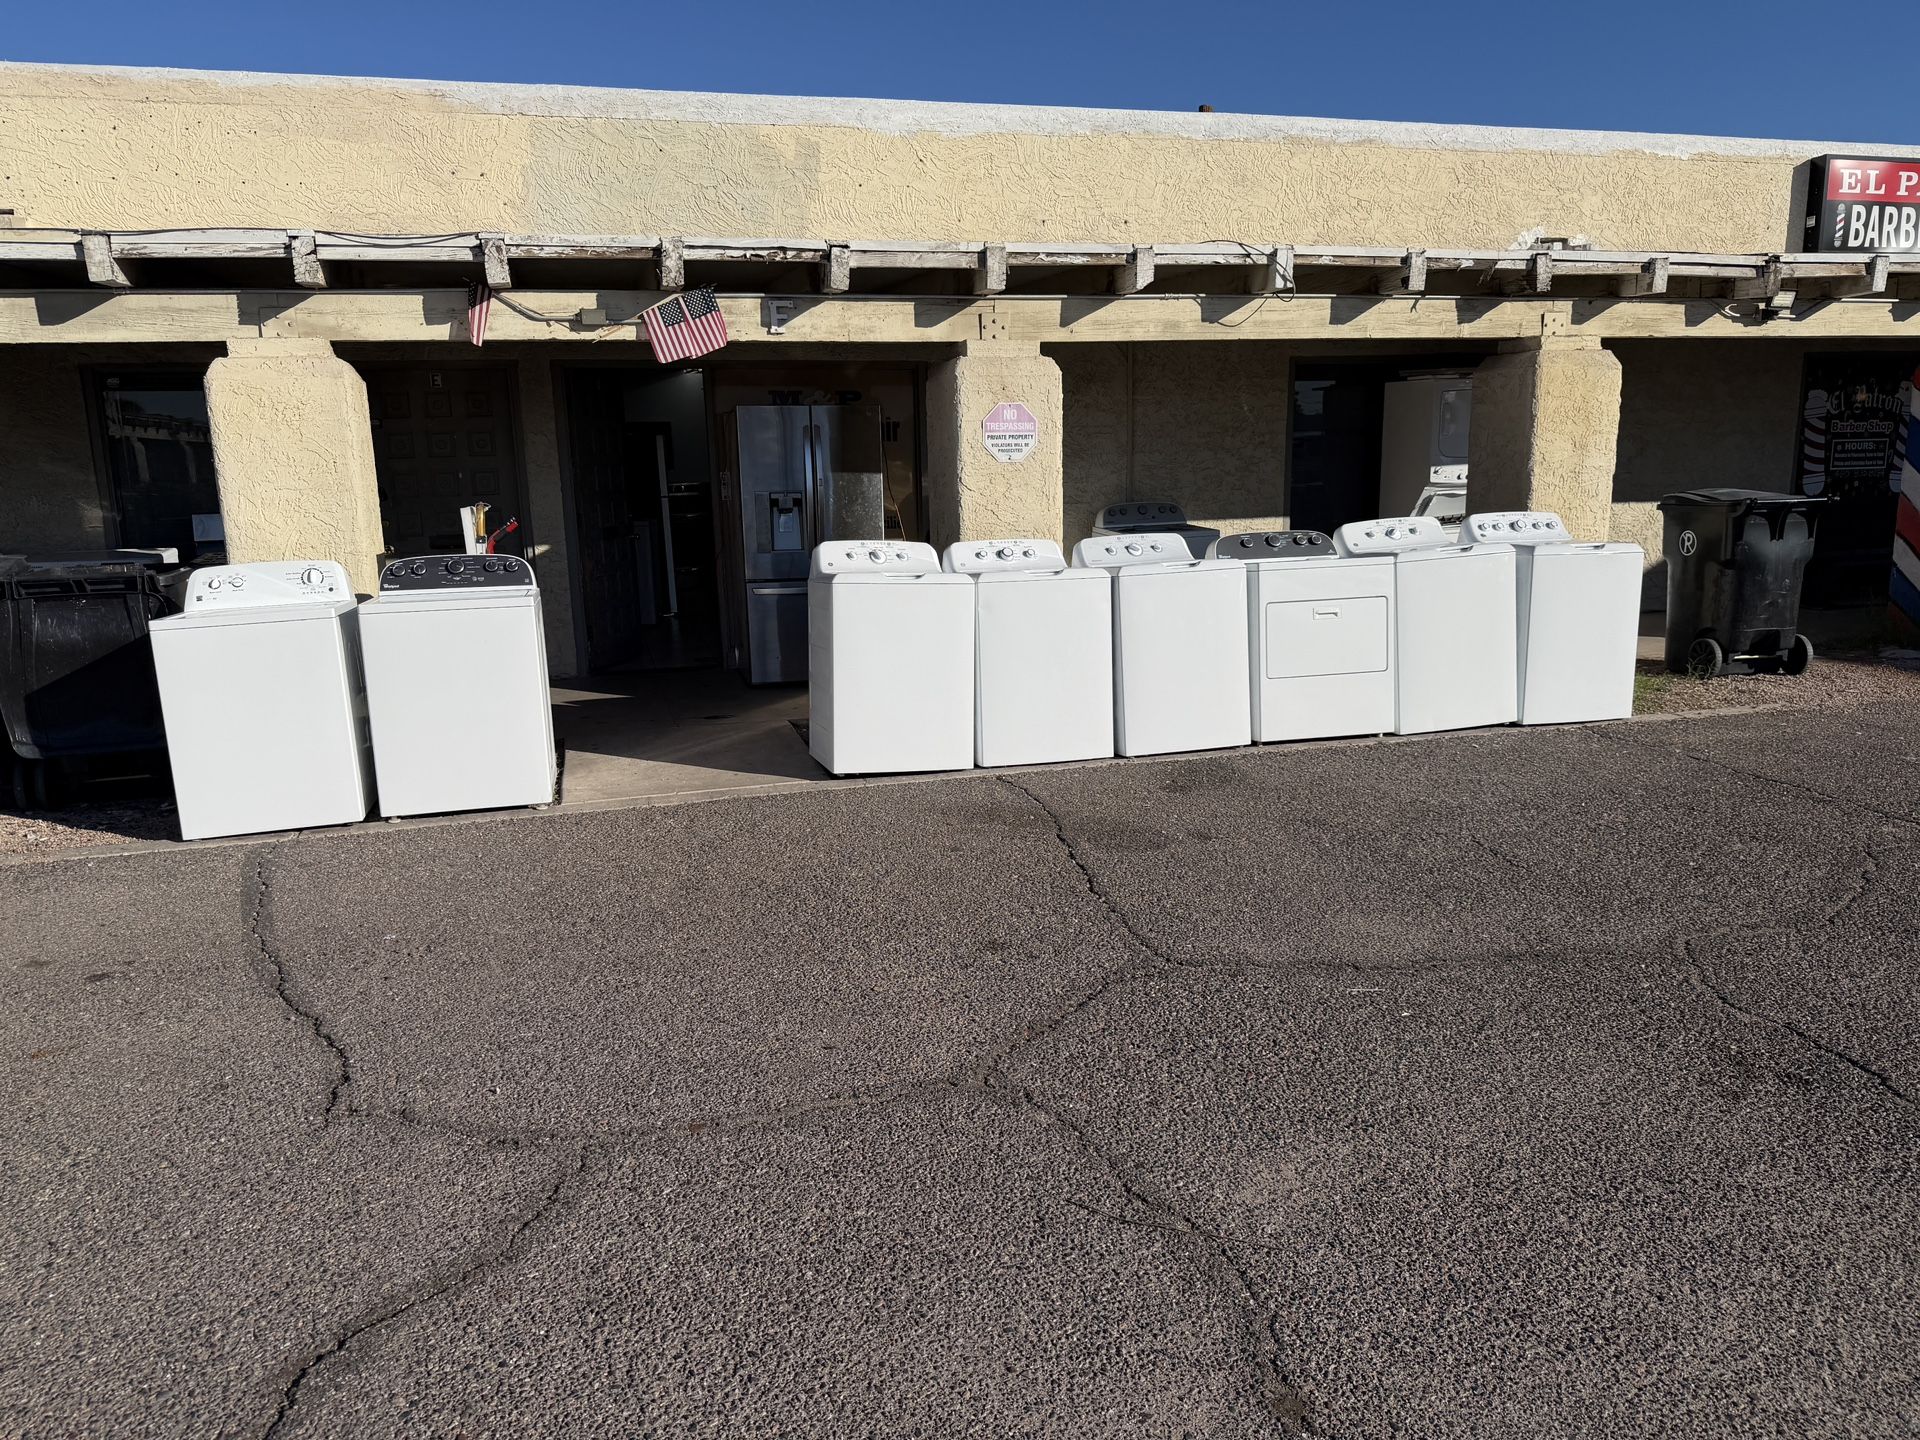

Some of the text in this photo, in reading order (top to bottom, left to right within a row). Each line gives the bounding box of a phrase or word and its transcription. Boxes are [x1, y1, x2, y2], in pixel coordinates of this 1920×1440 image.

[1839, 168, 1920, 196] EL P
[1848, 204, 1920, 249] BARB
[769, 300, 793, 334] F
[431, 374, 441, 387] E
[1003, 409, 1018, 420] NO
[985, 422, 1034, 431] TRESPASSING
[1831, 419, 1894, 435] Barber Shop
[1844, 442, 1875, 451] HOURS:
